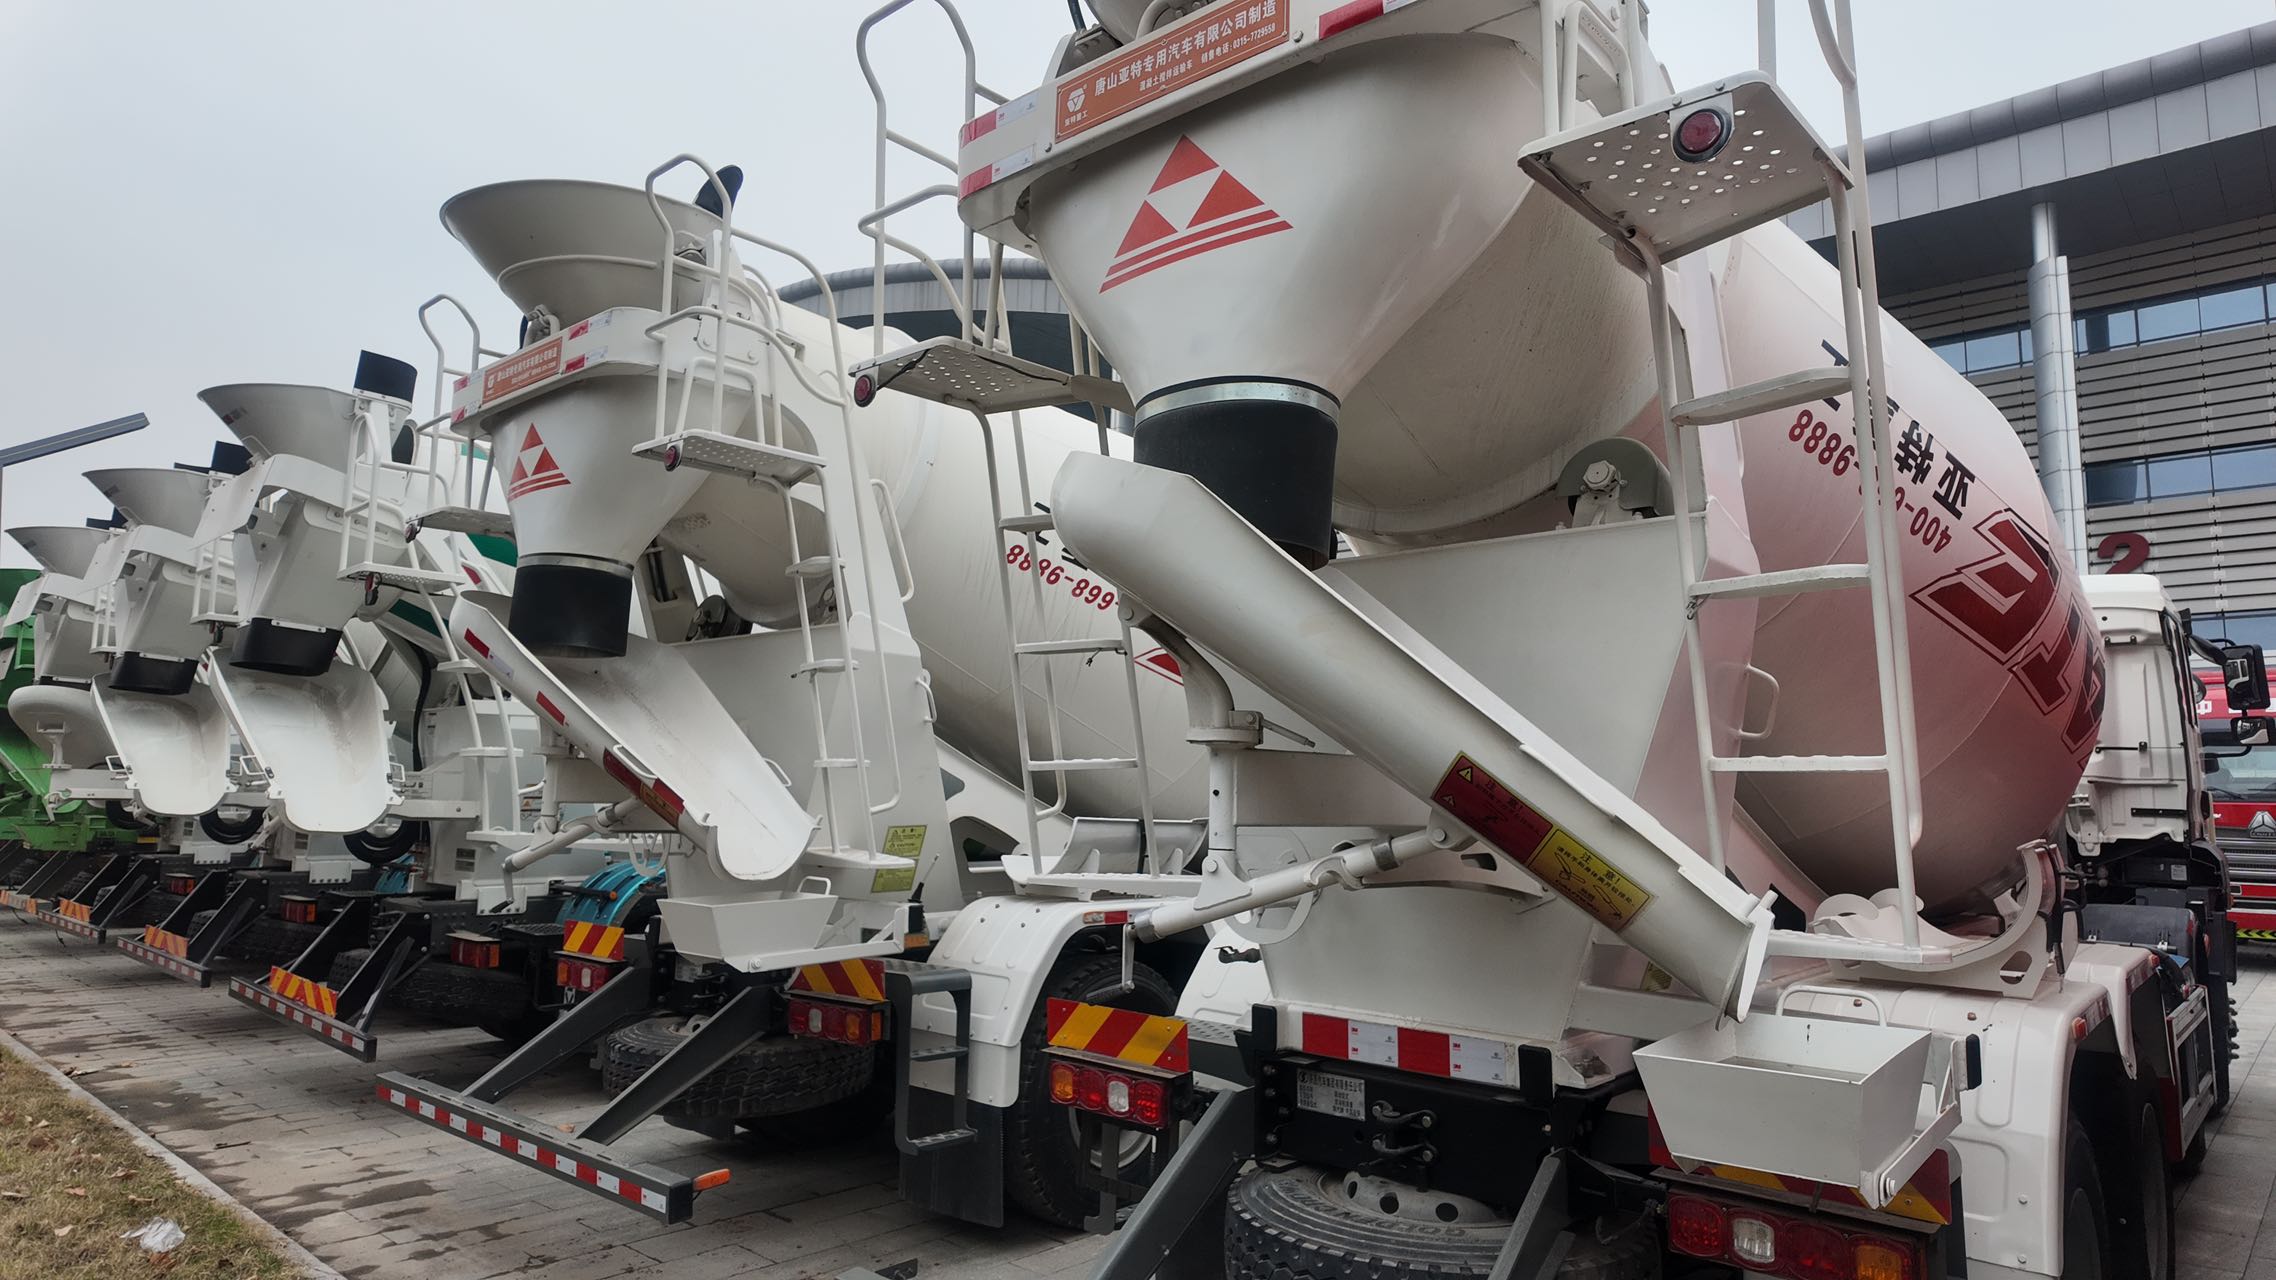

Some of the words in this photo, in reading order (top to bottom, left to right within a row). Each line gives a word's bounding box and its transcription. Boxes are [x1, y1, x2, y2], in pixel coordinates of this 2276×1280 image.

[1094, 0, 1277, 97] 唐山亚特专用汽车有限公司制造
[2097, 532, 2150, 574] 2
